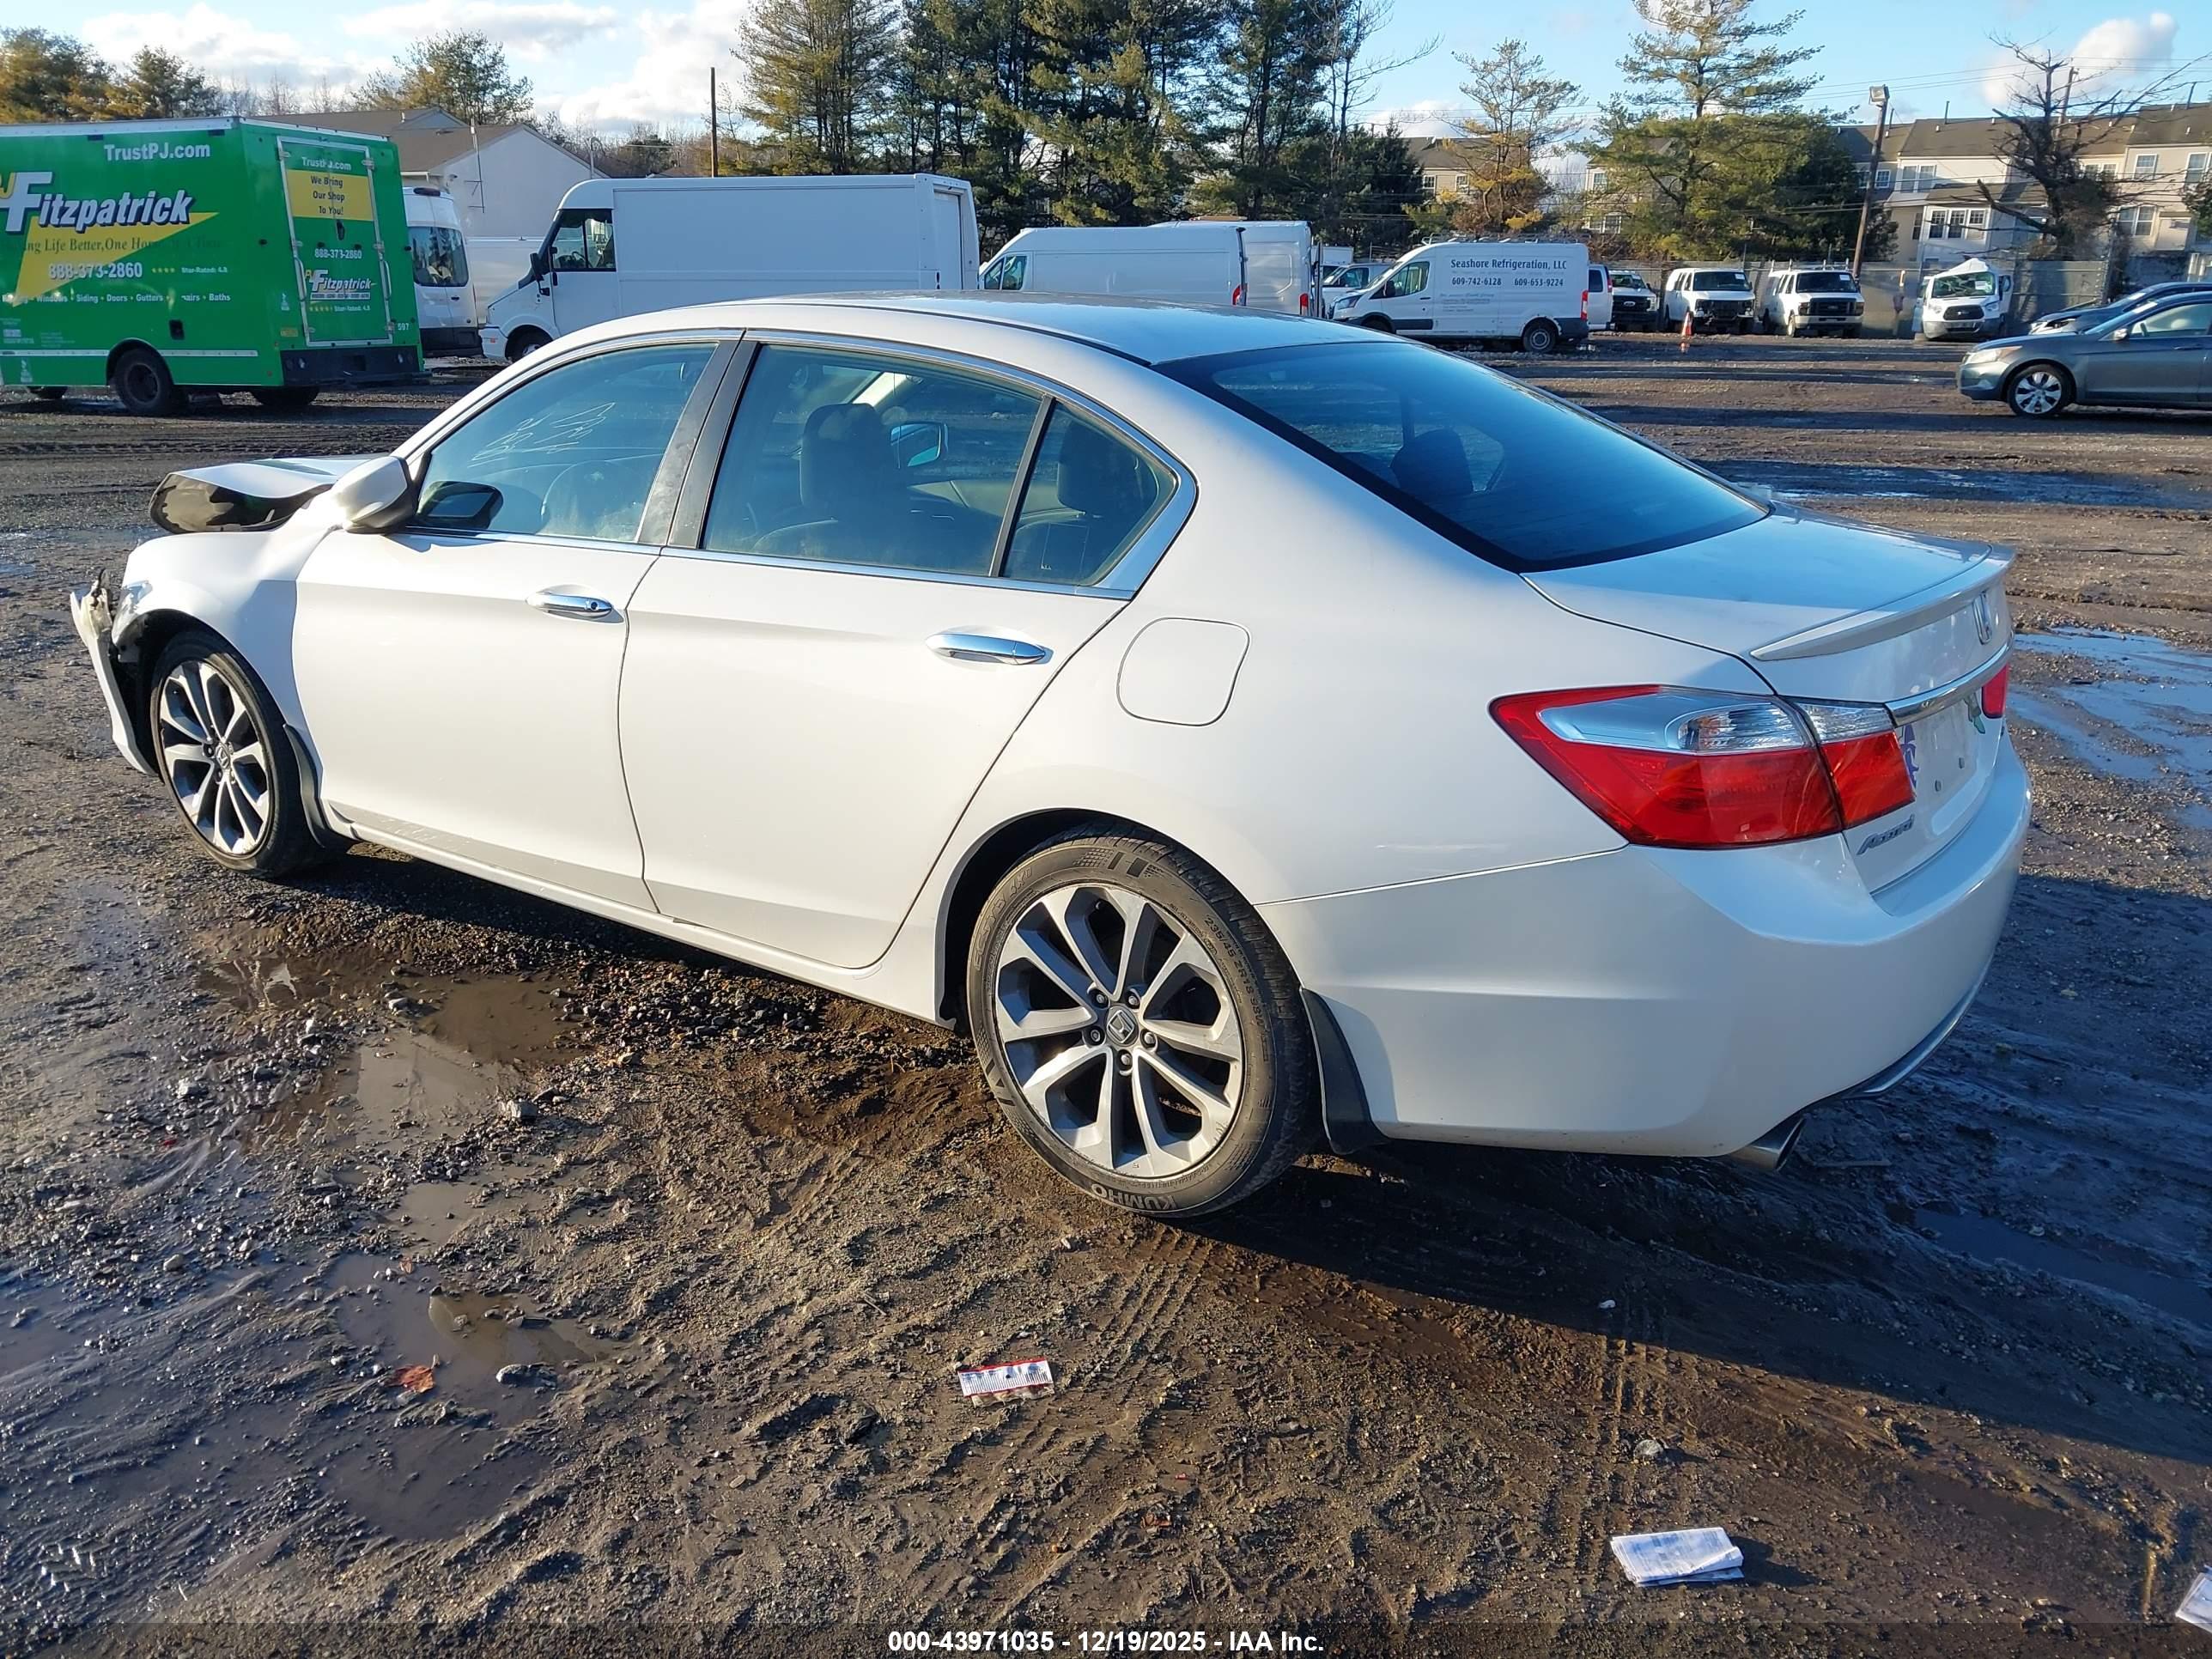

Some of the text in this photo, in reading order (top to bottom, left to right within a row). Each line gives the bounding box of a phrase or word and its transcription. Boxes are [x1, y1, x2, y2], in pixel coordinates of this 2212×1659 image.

[104, 142, 210, 161] TrustPJ.com
[310, 175, 343, 189] We Bring
[0, 171, 194, 234] Fitzpatrick
[313, 191, 345, 203] Our Shop
[45, 239, 66, 255] Life
[314, 248, 362, 259] 888-373-2860
[49, 261, 143, 279] 888-373-2860
[1450, 258, 1567, 270] Seashore Refrigeration, LLC
[309, 270, 372, 292] Fitzpatrick
[1451, 276, 1502, 286] 609-742-6128
[1514, 277, 1564, 287] 609-653-9224
[76, 293, 99, 304] Siding
[106, 293, 128, 302] Doors
[136, 293, 164, 301] Gutters
[209, 293, 231, 301] Baths
[397, 322, 410, 331] 597
[1204, 915, 1237, 957] 235/45
[1091, 1183, 1178, 1210] KUMHO
